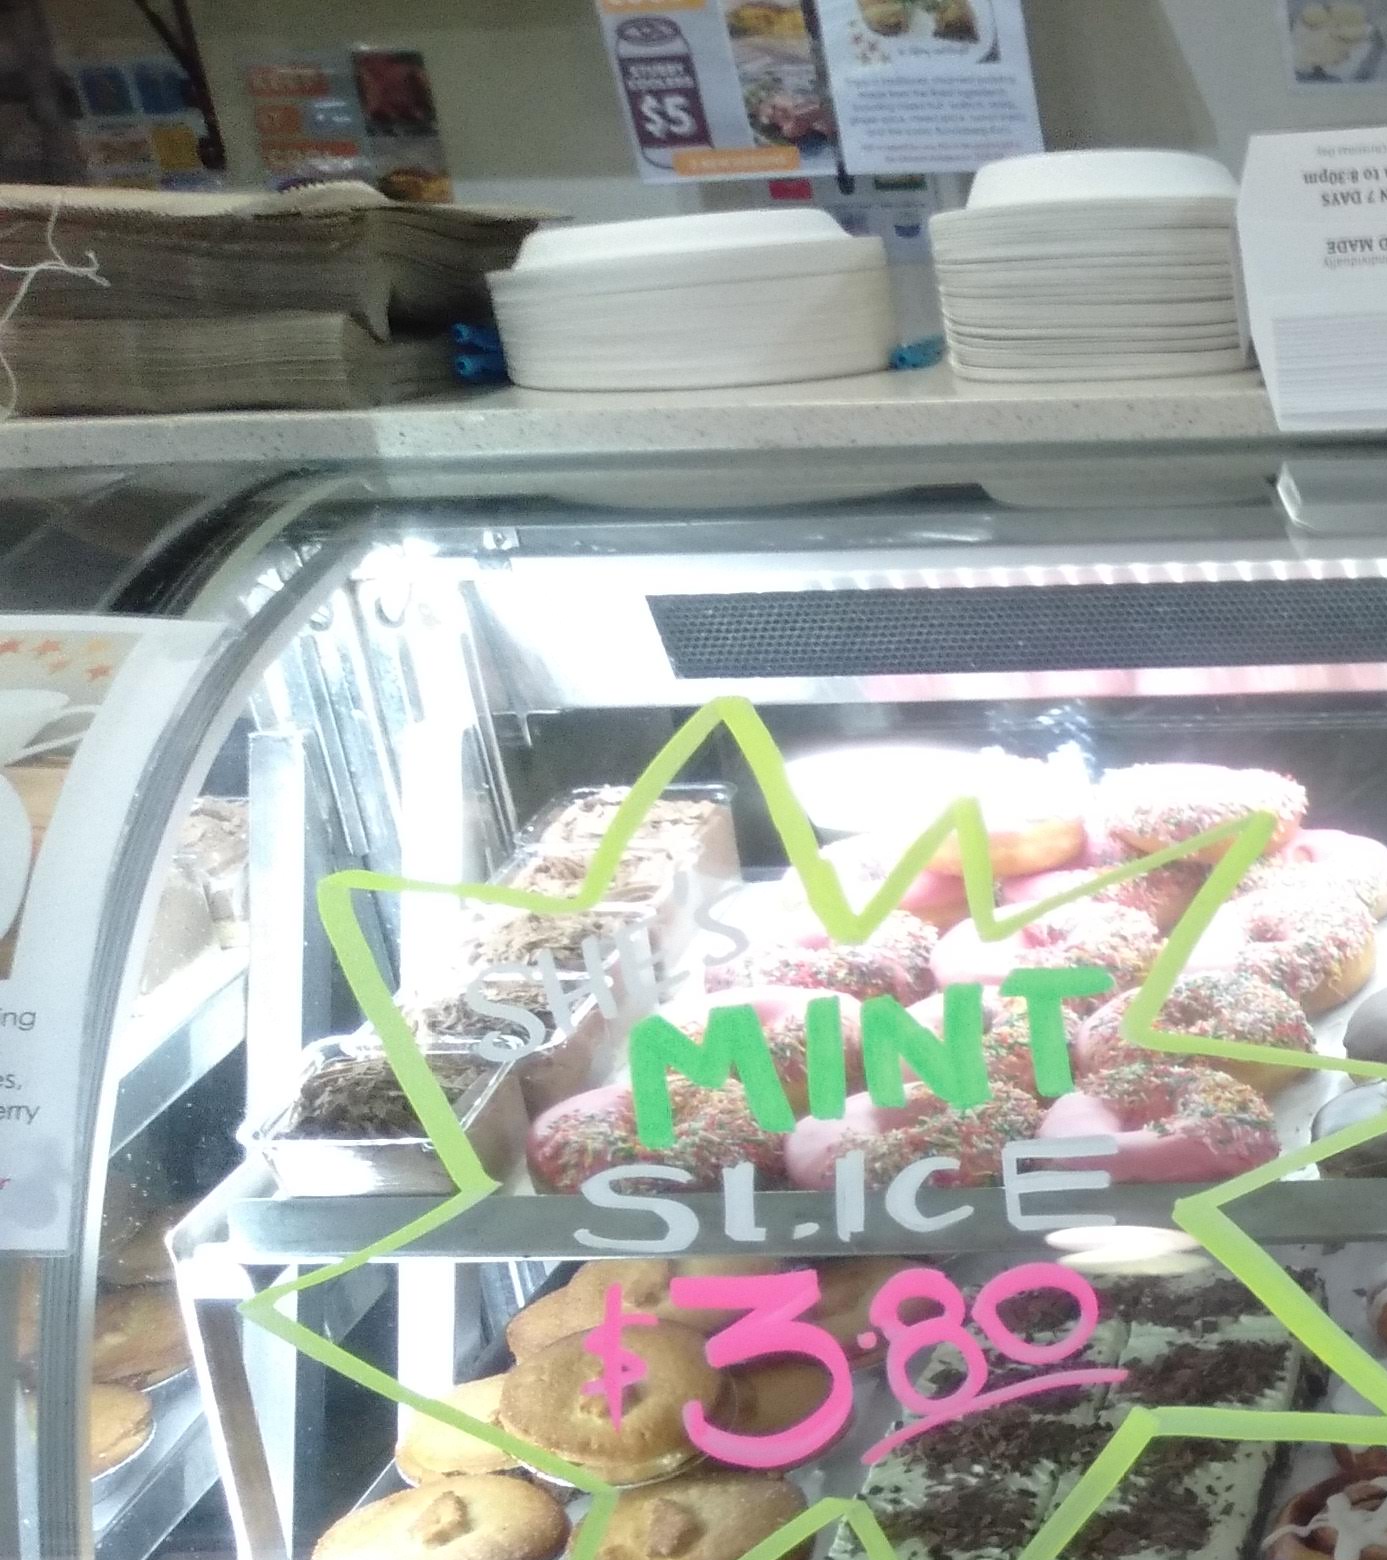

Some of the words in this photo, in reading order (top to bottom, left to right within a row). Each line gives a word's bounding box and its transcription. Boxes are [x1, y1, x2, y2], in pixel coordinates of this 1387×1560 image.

[641, 94, 696, 139] $5
[1363, 167, 1380, 180] to
[1321, 191, 1363, 207] DAYS
[1326, 238, 1374, 255] MADE
[628, 967, 1116, 1149] MINT
[582, 1262, 1098, 1469] $3.80
